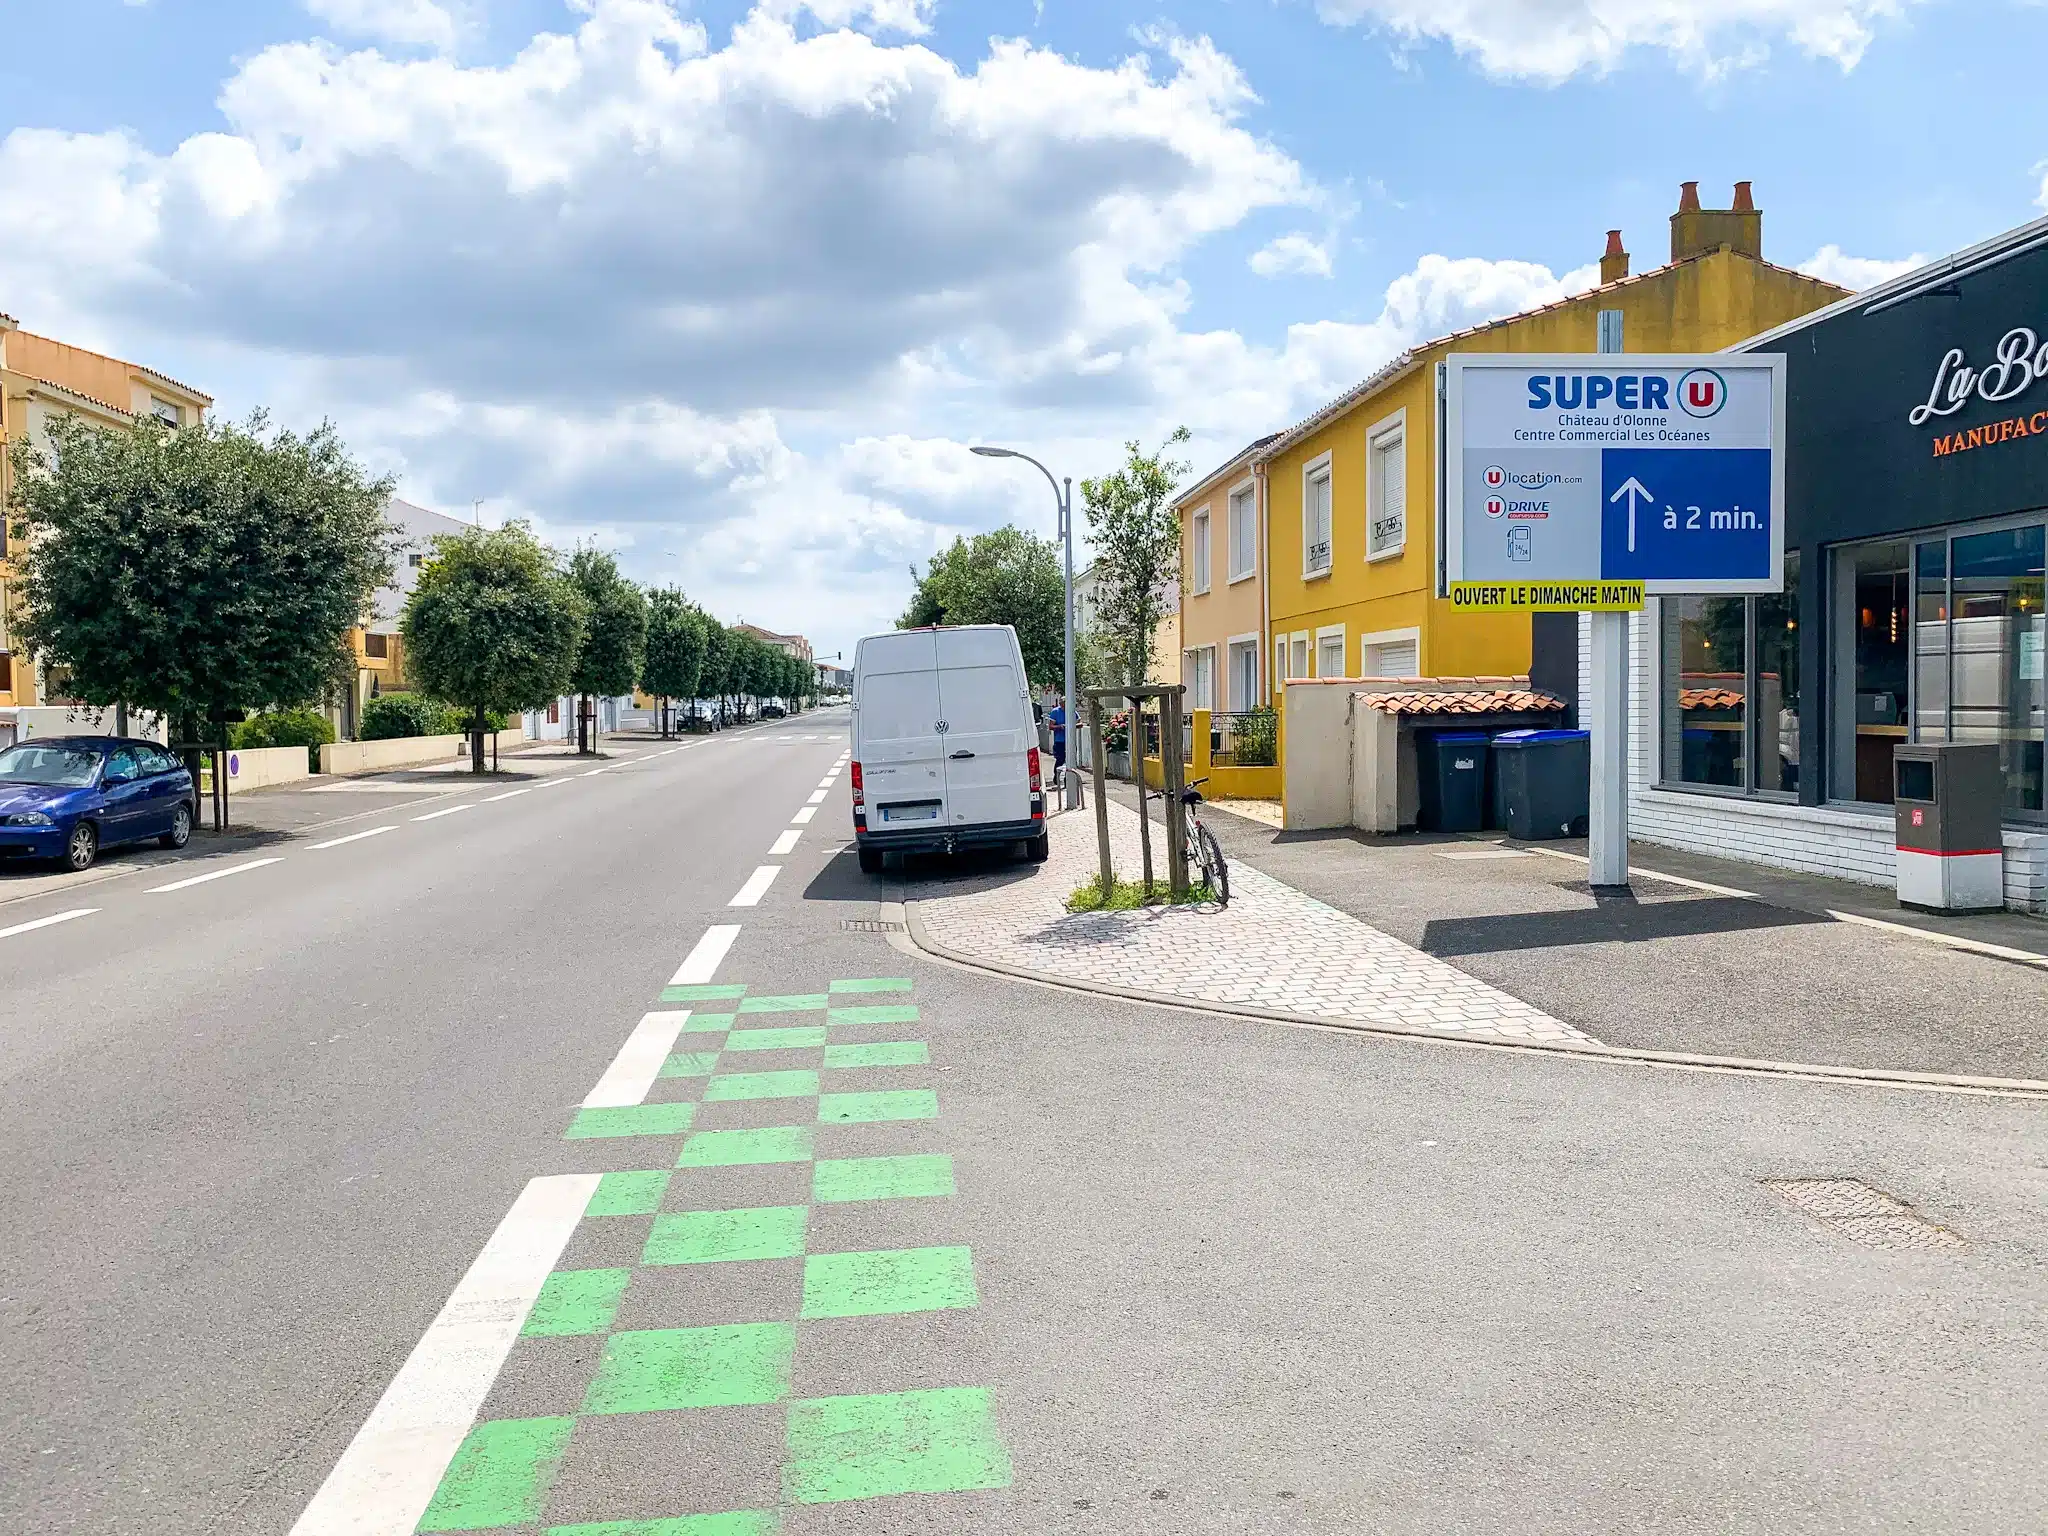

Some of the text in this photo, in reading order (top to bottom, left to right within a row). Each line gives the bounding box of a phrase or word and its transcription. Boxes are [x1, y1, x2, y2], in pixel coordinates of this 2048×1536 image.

[1528, 375, 1669, 410] SUPER
[1909, 348, 1978, 425] La
[1558, 414, 1667, 426] Château d'Olonne
[1514, 429, 1710, 441] Centre Commercial Les Océanes
[1509, 472, 1582, 483] location.com
[1509, 502, 1549, 511] DRIVE
[1664, 506, 1763, 530] à 2 min.
[1454, 586, 1641, 605] OUVERT LE DIMANCHE MATIN
